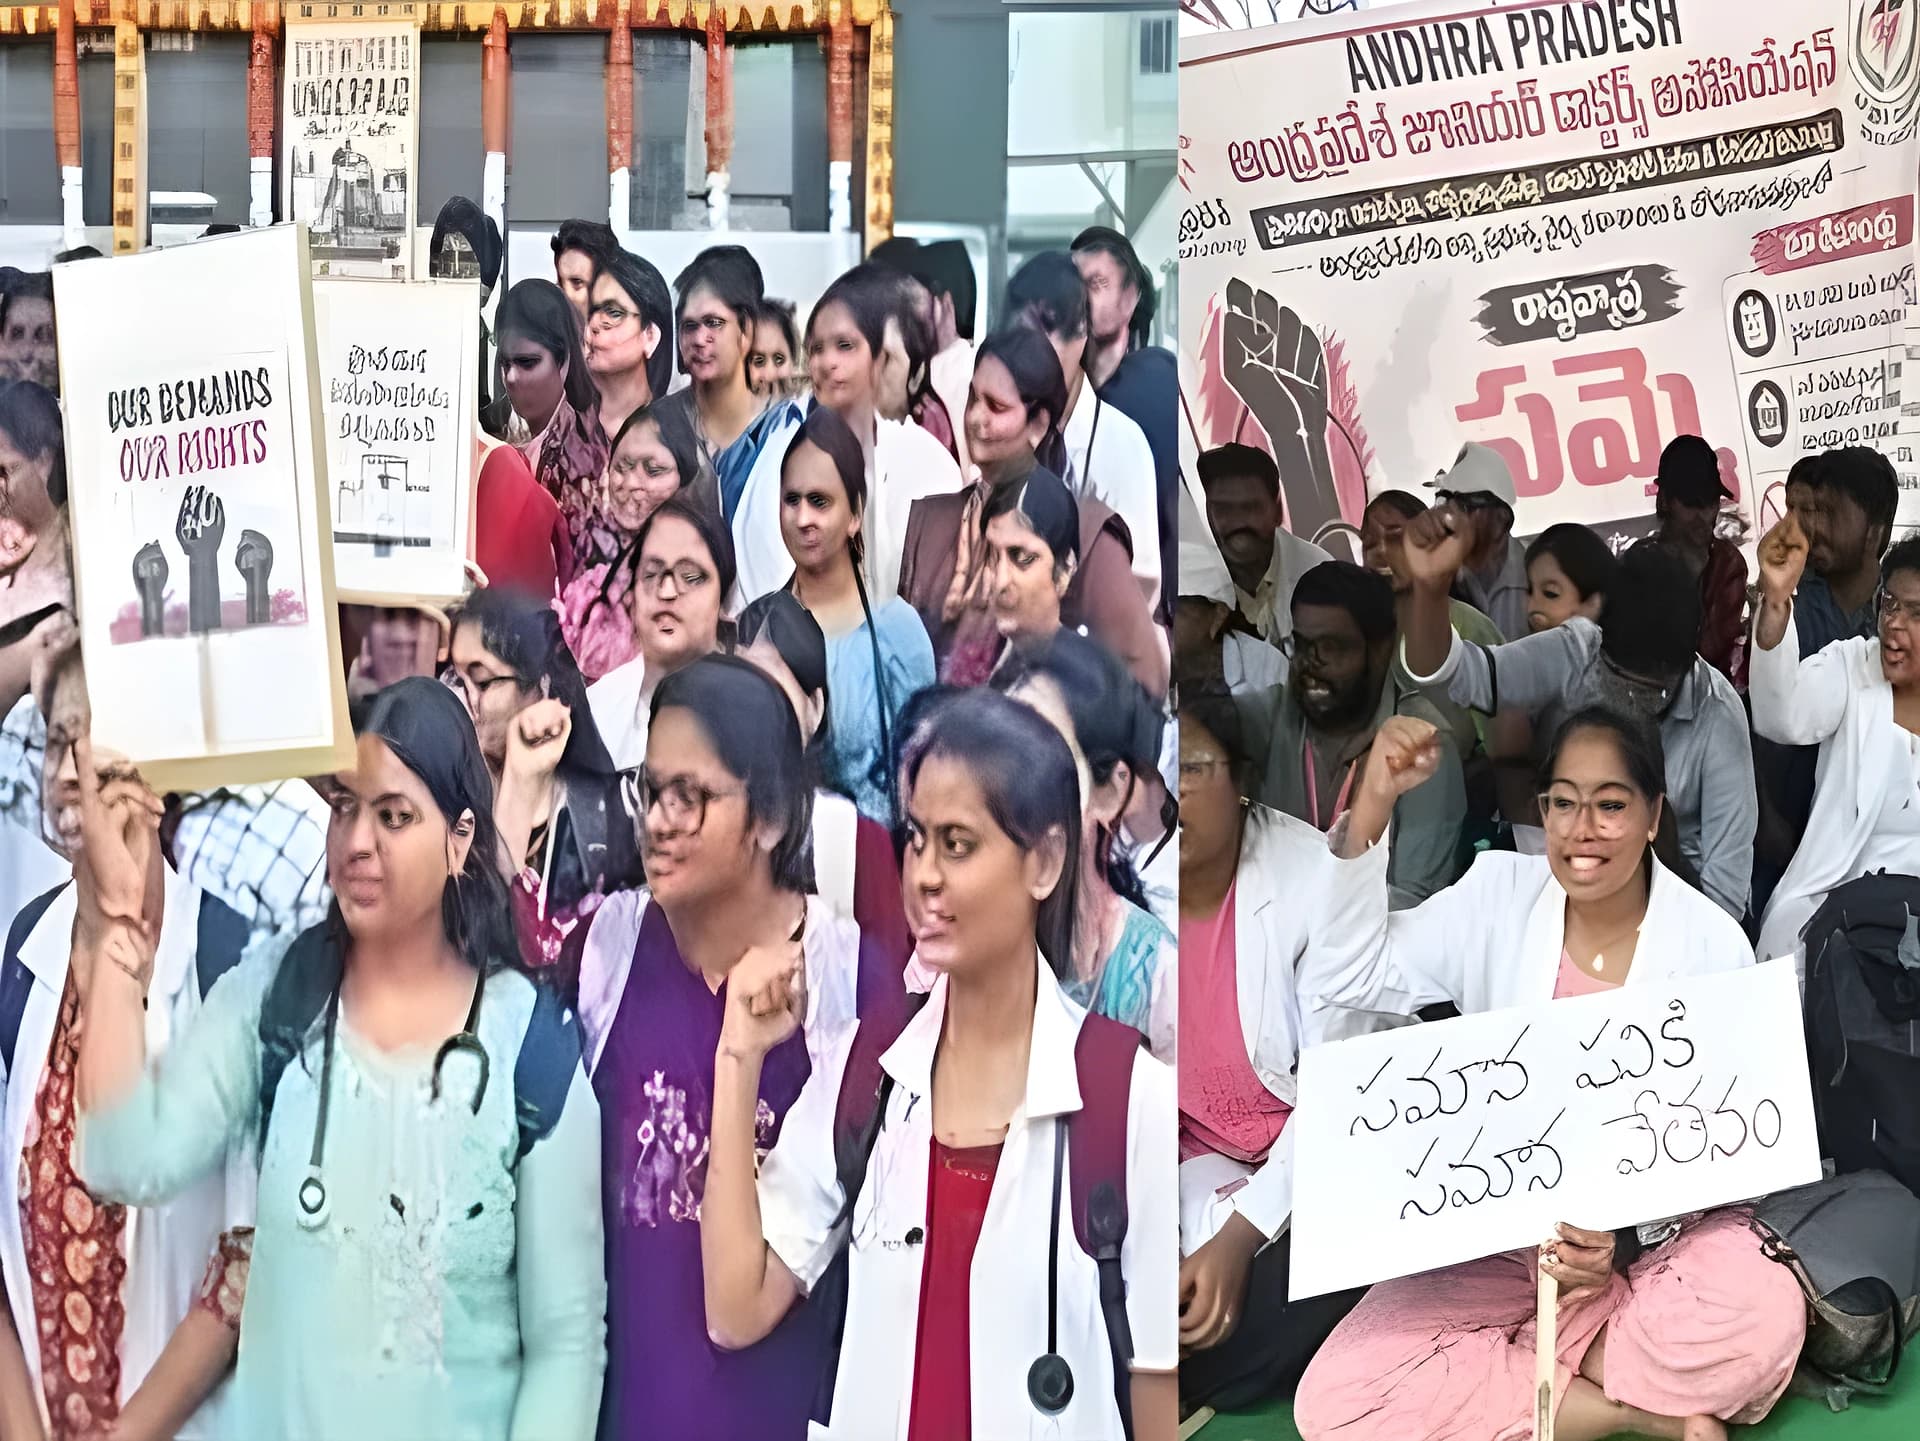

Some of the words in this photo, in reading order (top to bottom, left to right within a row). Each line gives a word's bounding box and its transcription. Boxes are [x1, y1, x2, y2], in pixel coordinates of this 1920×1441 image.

[1346, 16, 1504, 94] ANDHRA
[1506, 0, 1683, 70] PRADESH
[1402, 79, 1546, 155] జూనియర్
[108, 386, 153, 433] OUR
[120, 434, 170, 483] OUR
[1350, 1024, 1531, 1137] సమాన
[1400, 1107, 1567, 1220] సమాన
[1602, 1074, 1782, 1176] వేతనం
